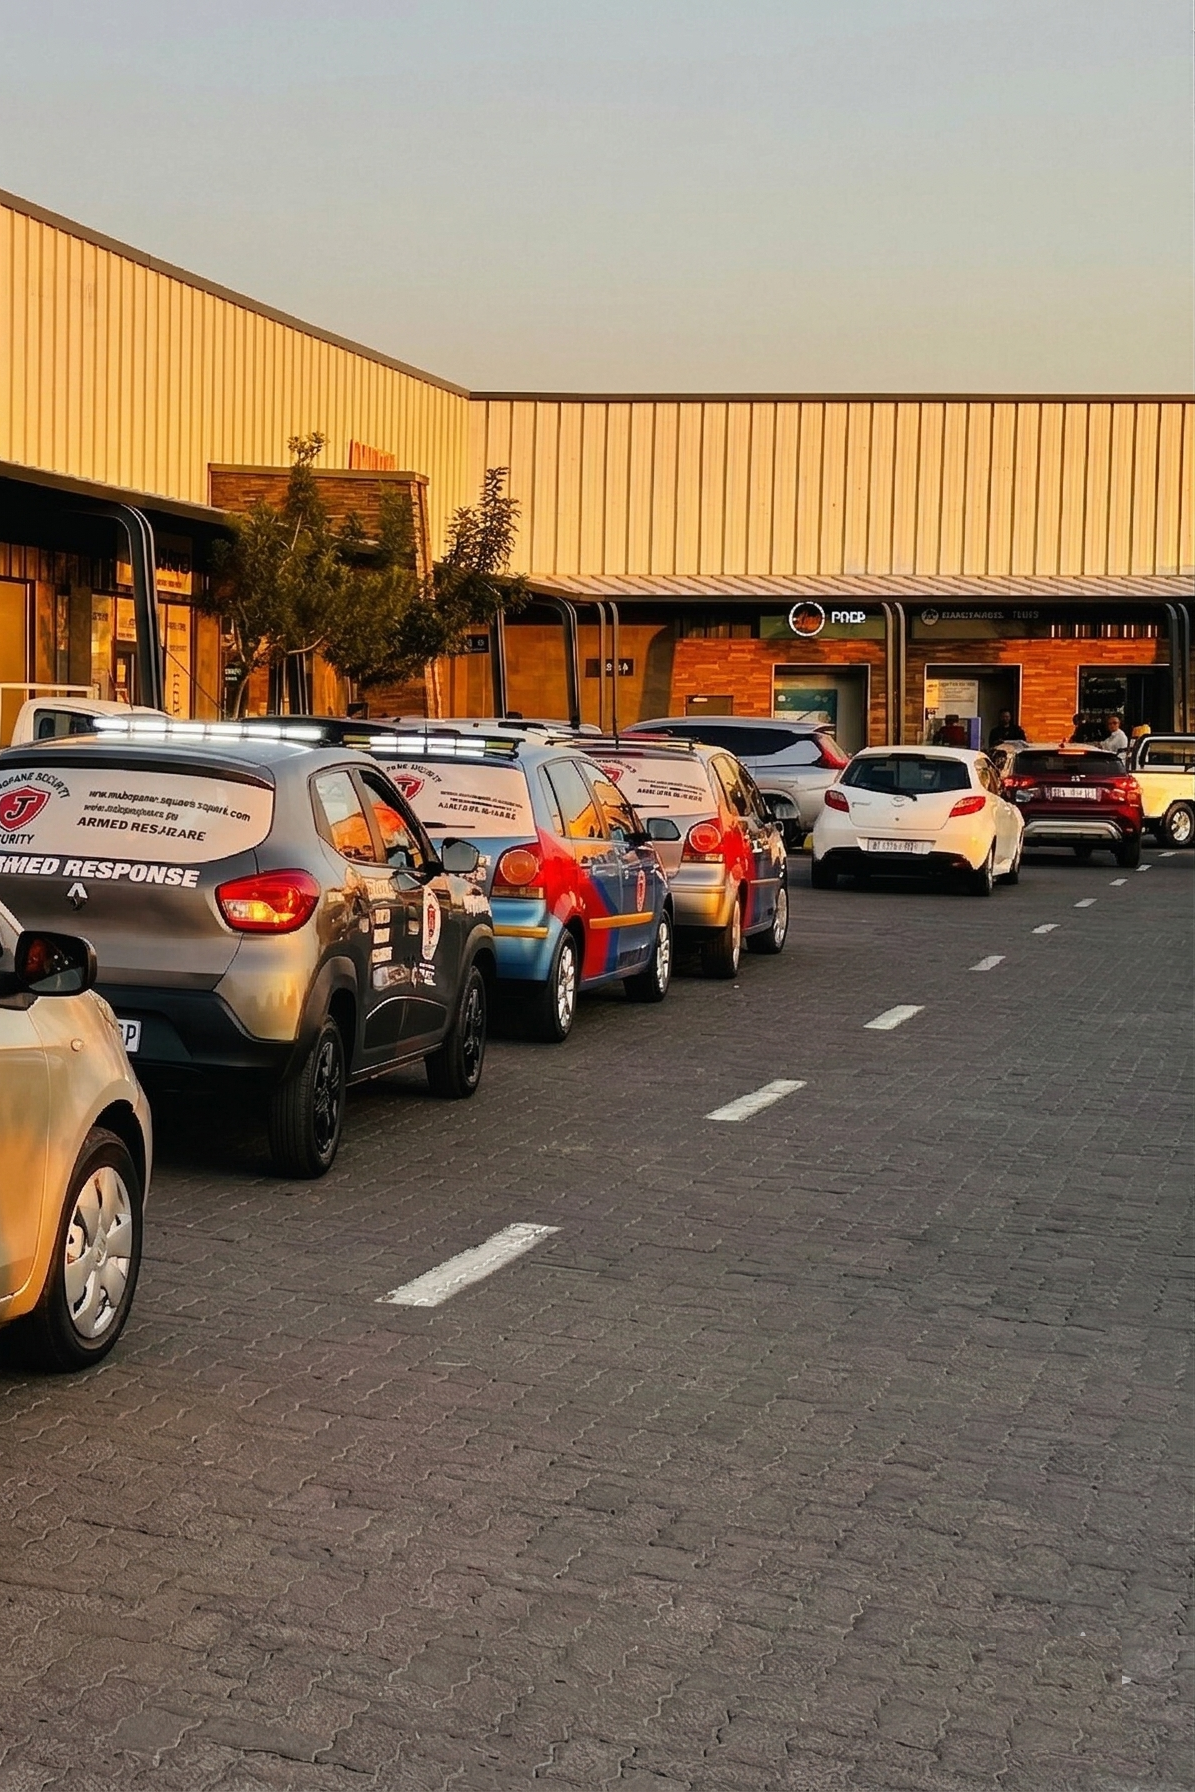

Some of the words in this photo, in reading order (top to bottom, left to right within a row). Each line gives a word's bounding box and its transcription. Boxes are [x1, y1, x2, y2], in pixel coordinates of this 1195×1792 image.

[5, 796, 37, 820] J
[76, 816, 128, 830] ARMED
[62, 858, 200, 888] RESPONSE
